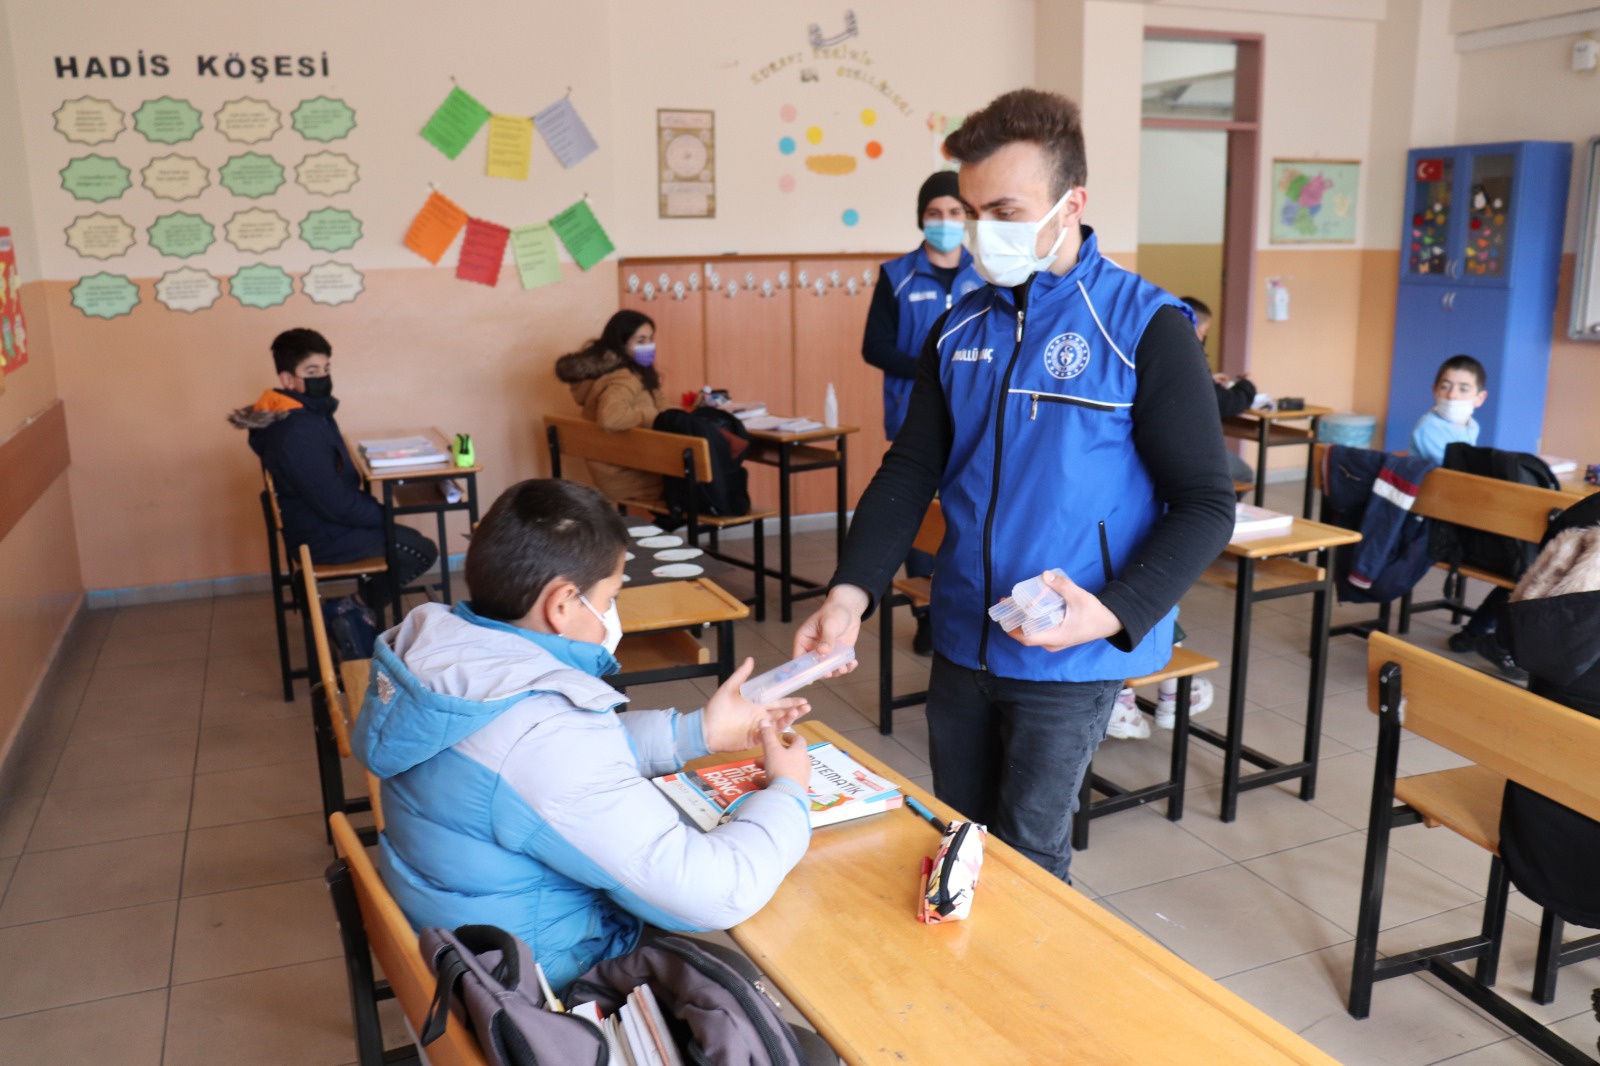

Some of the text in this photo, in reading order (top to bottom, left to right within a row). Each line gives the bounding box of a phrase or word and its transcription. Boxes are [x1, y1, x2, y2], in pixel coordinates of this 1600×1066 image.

[54, 49, 329, 83] HADİS KÖŞESİ
[703, 771, 743, 796] RANG
